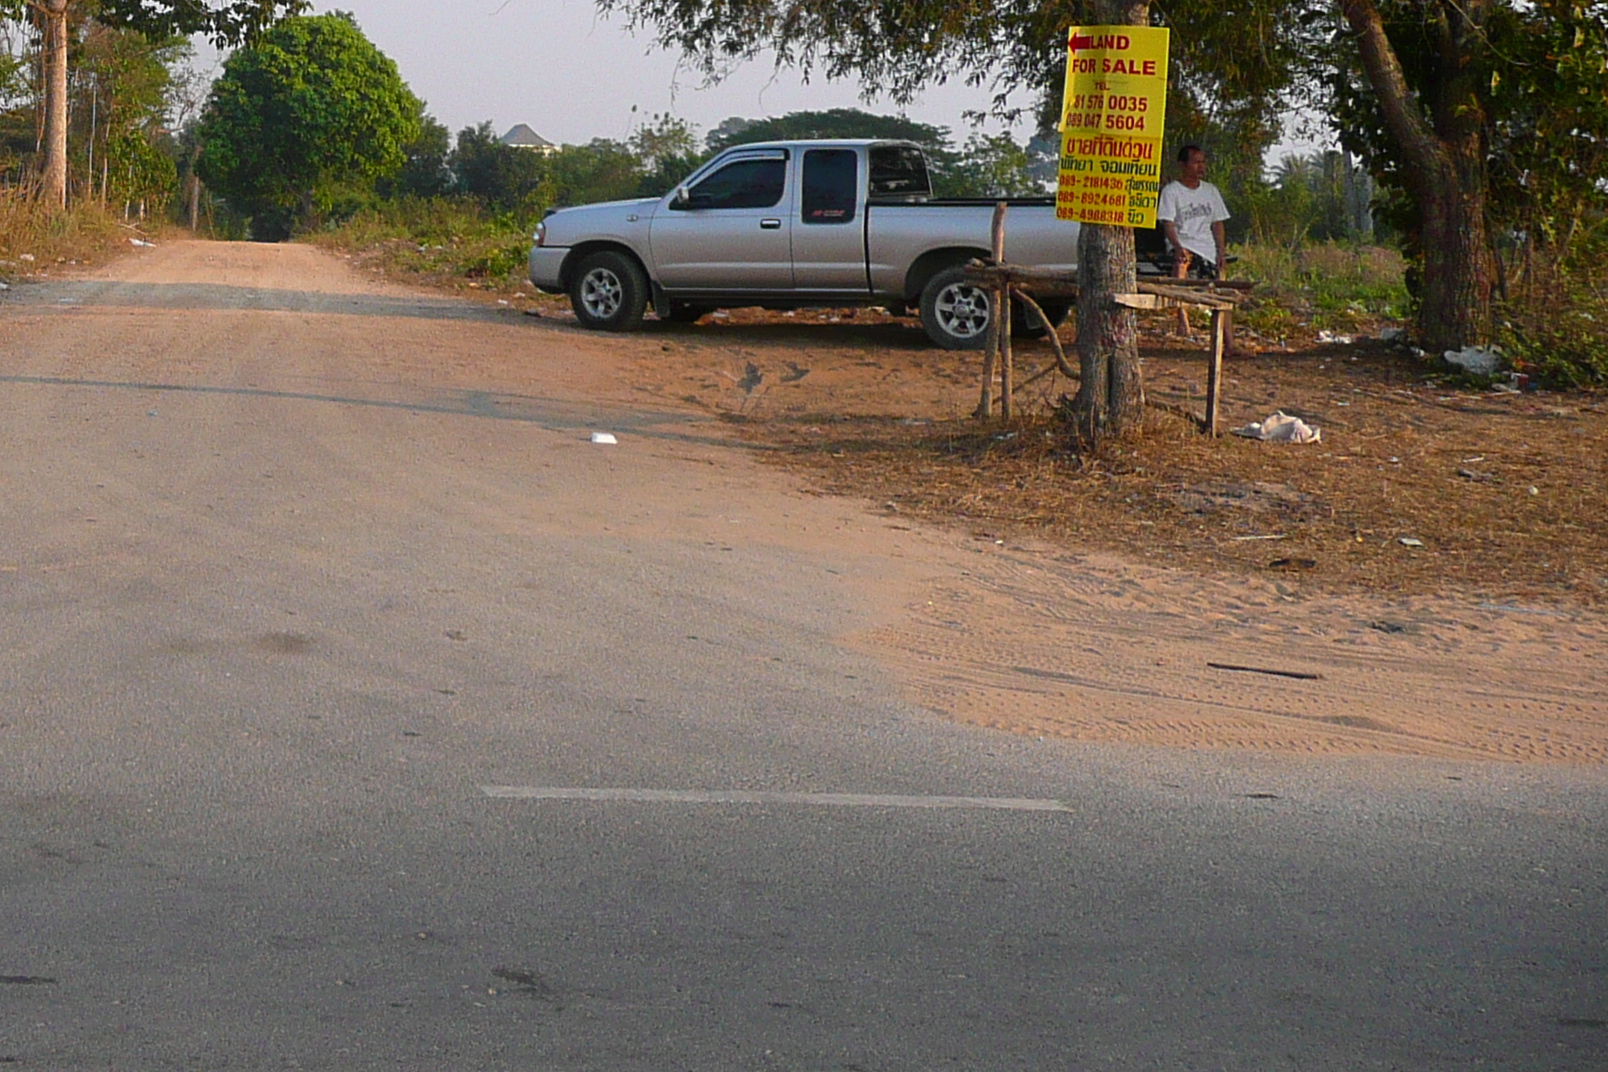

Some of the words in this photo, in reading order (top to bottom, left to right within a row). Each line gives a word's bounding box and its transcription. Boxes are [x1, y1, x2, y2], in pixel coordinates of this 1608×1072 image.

[1091, 35, 1130, 50] LAND
[1072, 59, 1096, 73] FOR
[1102, 58, 1156, 75] SALE
[1108, 95, 1148, 112] 0035
[1105, 115, 1145, 131] 5604
[1066, 136, 1153, 160] ขายที่ดินด่วน
